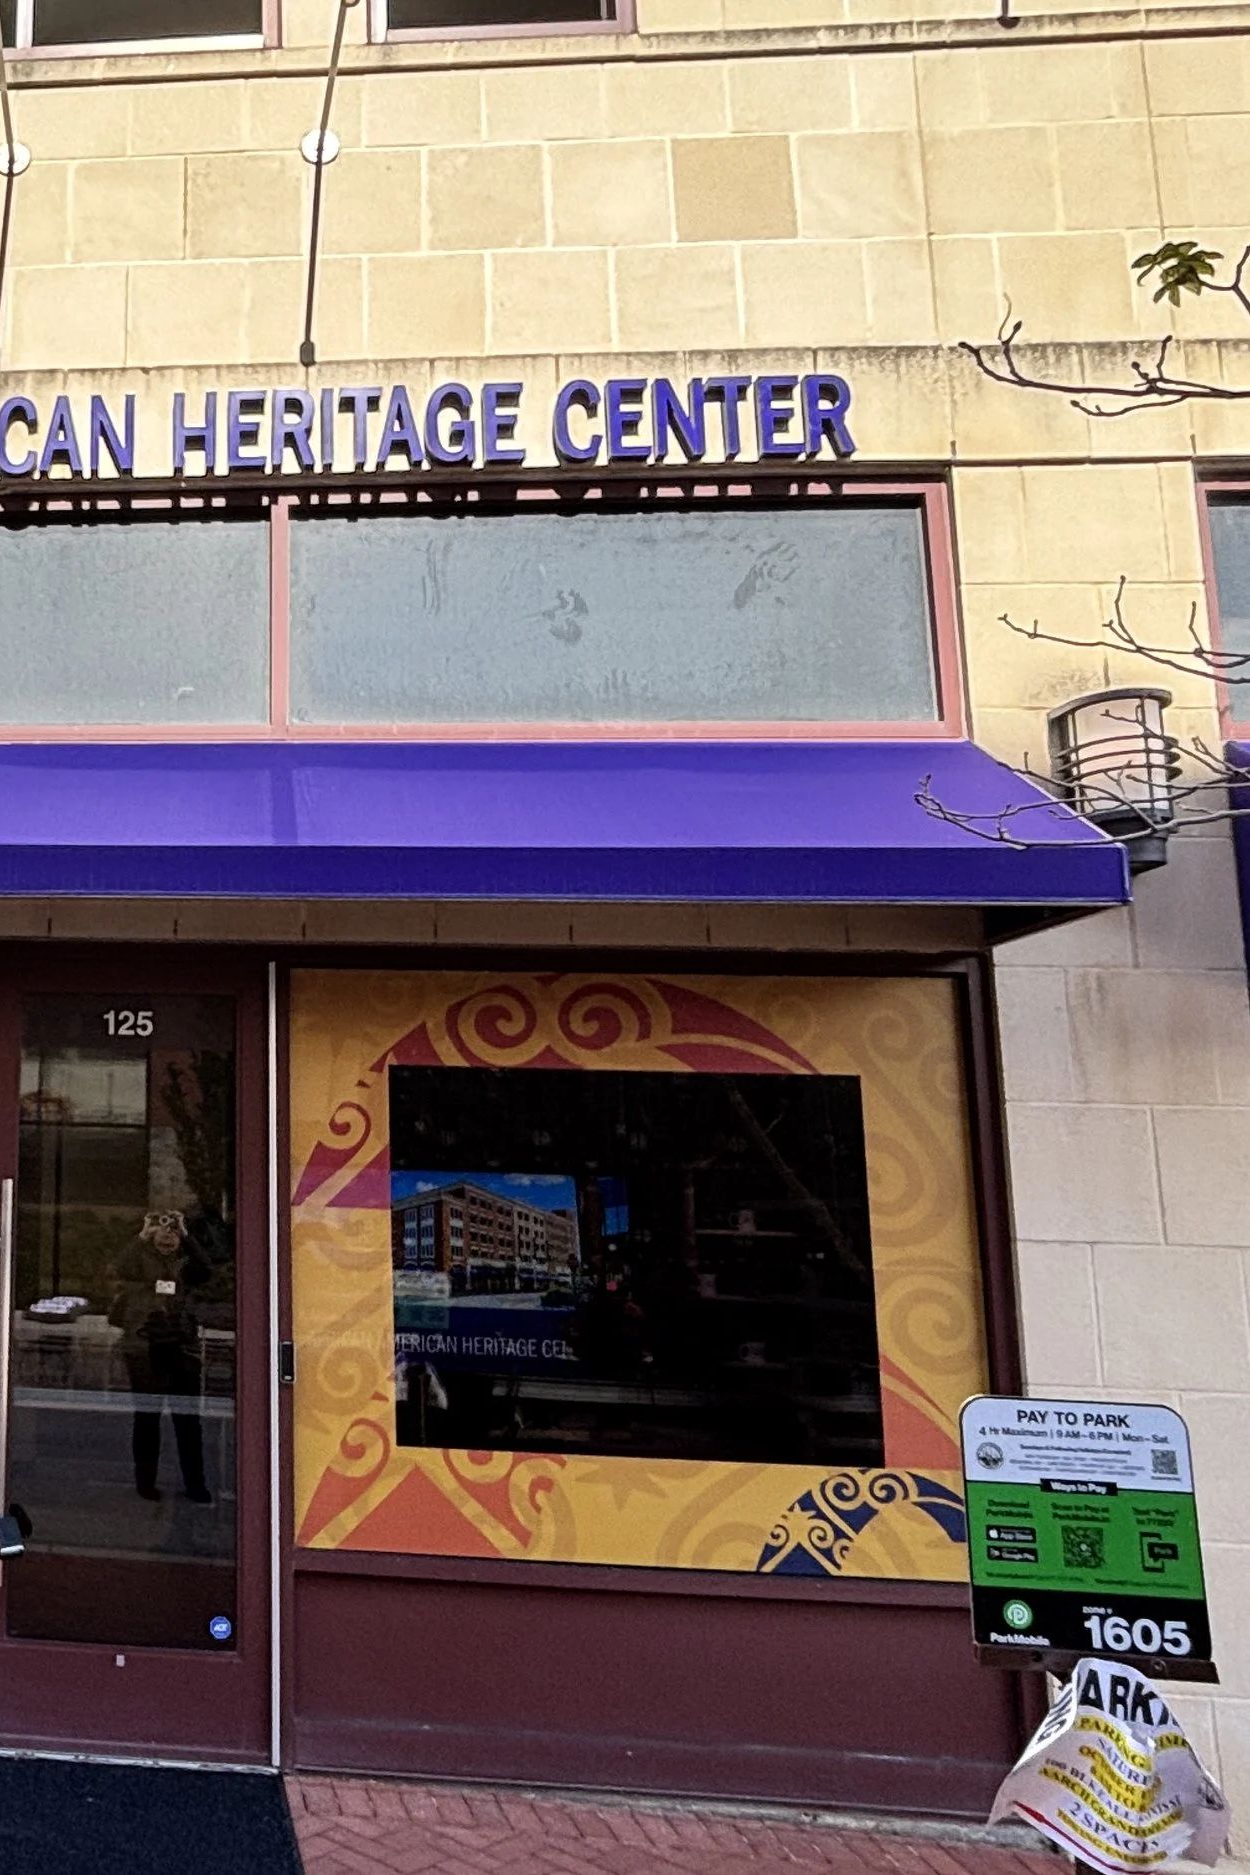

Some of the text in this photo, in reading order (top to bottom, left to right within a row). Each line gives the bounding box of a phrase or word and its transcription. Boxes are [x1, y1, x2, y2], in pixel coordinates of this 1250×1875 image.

[172, 382, 526, 474] HERITAGE
[553, 374, 857, 461] CENTER
[103, 1010, 153, 1036] 125
[462, 1336, 538, 1357] HERITAGE
[1017, 1409, 1130, 1428] PAY TO PARK
[979, 1427, 987, 1436] 4
[1002, 1427, 1047, 1437] Maximum
[1050, 1481, 1077, 1492] Ways
[1088, 1483, 1107, 1494] Pay
[990, 1632, 1050, 1646] ParkMobile
[1084, 1615, 1192, 1656] 1605
